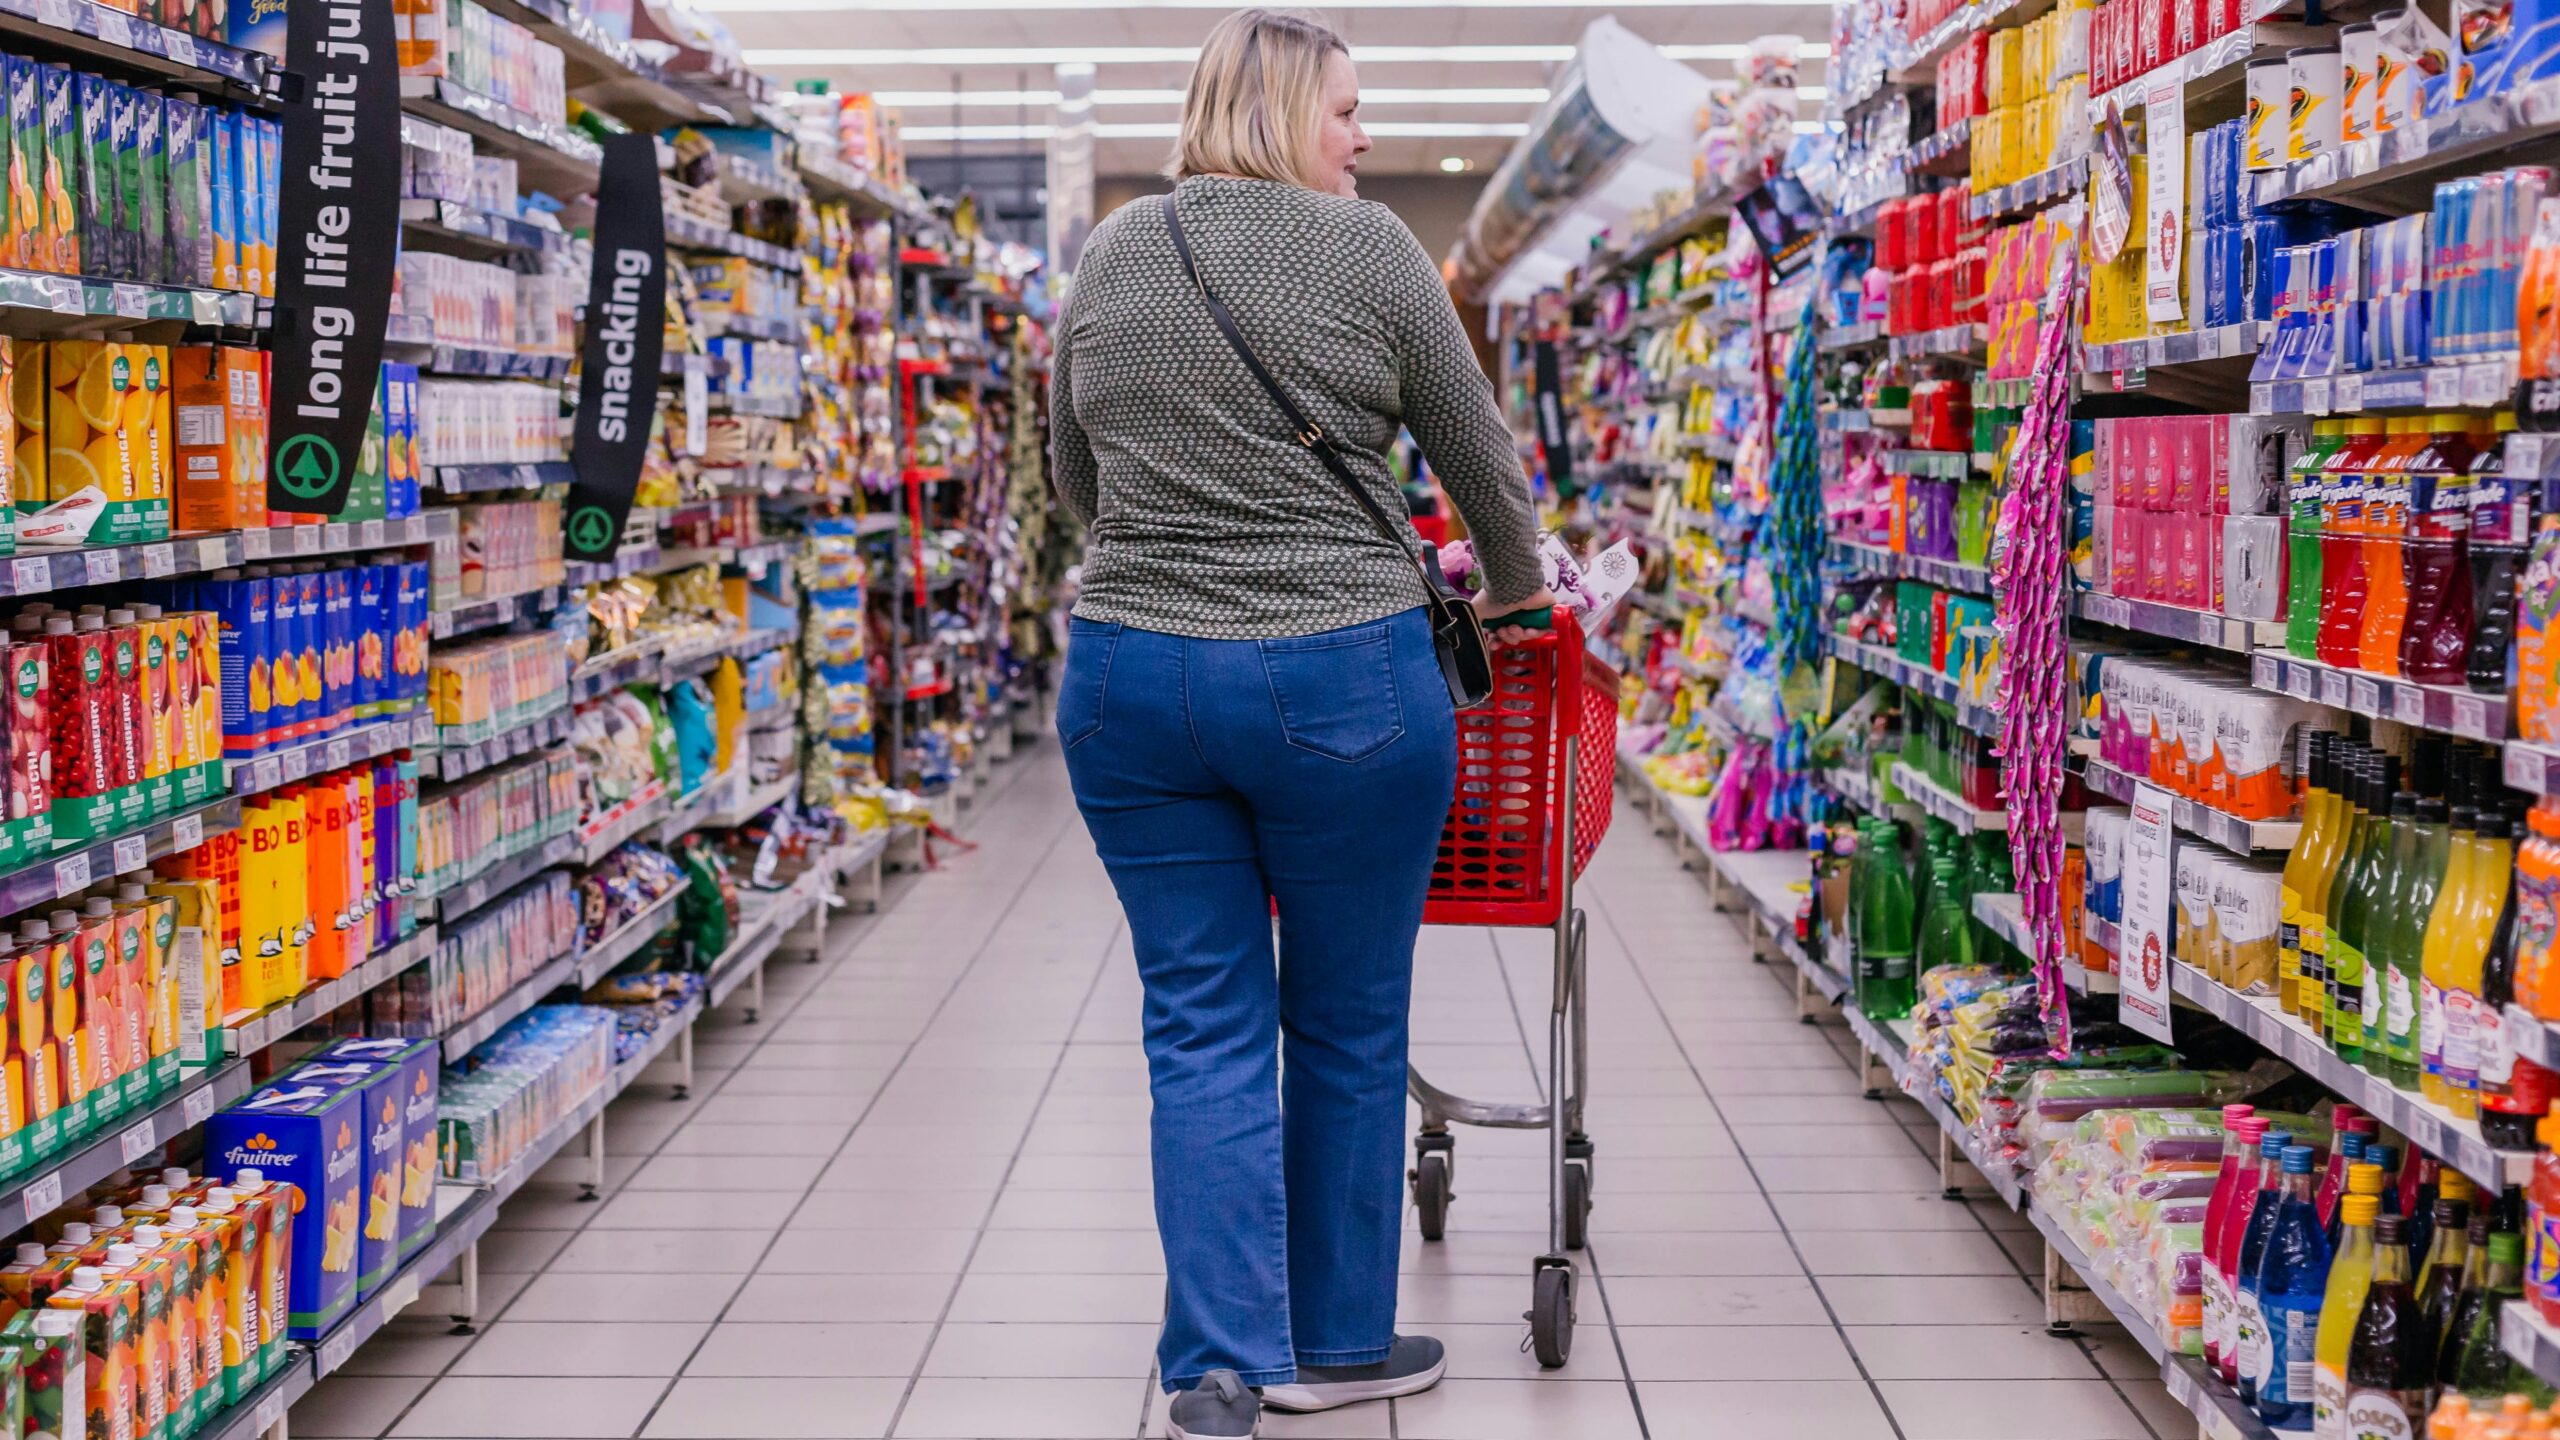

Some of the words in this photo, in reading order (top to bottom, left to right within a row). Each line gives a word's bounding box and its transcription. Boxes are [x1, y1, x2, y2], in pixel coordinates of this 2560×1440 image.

[309, 73, 358, 190] fruit
[304, 205, 350, 287] life
[298, 306, 355, 418] long
[598, 248, 652, 443] snacking
[117, 429, 133, 497] ORANGE
[149, 428, 161, 496] ORANGE
[90, 699, 105, 789] CRANBERRY
[122, 692, 137, 780] CRANBERRY
[153, 688, 165, 772] TROPICAL
[180, 681, 196, 762] TROPICAL
[27, 751, 43, 810] LITCHI
[129, 1010, 141, 1065] GUAVA
[160, 966, 172, 1049] PINEAPPLE
[34, 1048, 49, 1115] MANGO
[67, 1033, 82, 1098] MANGO
[97, 1024, 110, 1080] GUAVA
[225, 1145, 292, 1168] fruitree
[247, 1289, 258, 1354] ORANGE
[275, 1269, 286, 1331] ORANGE
